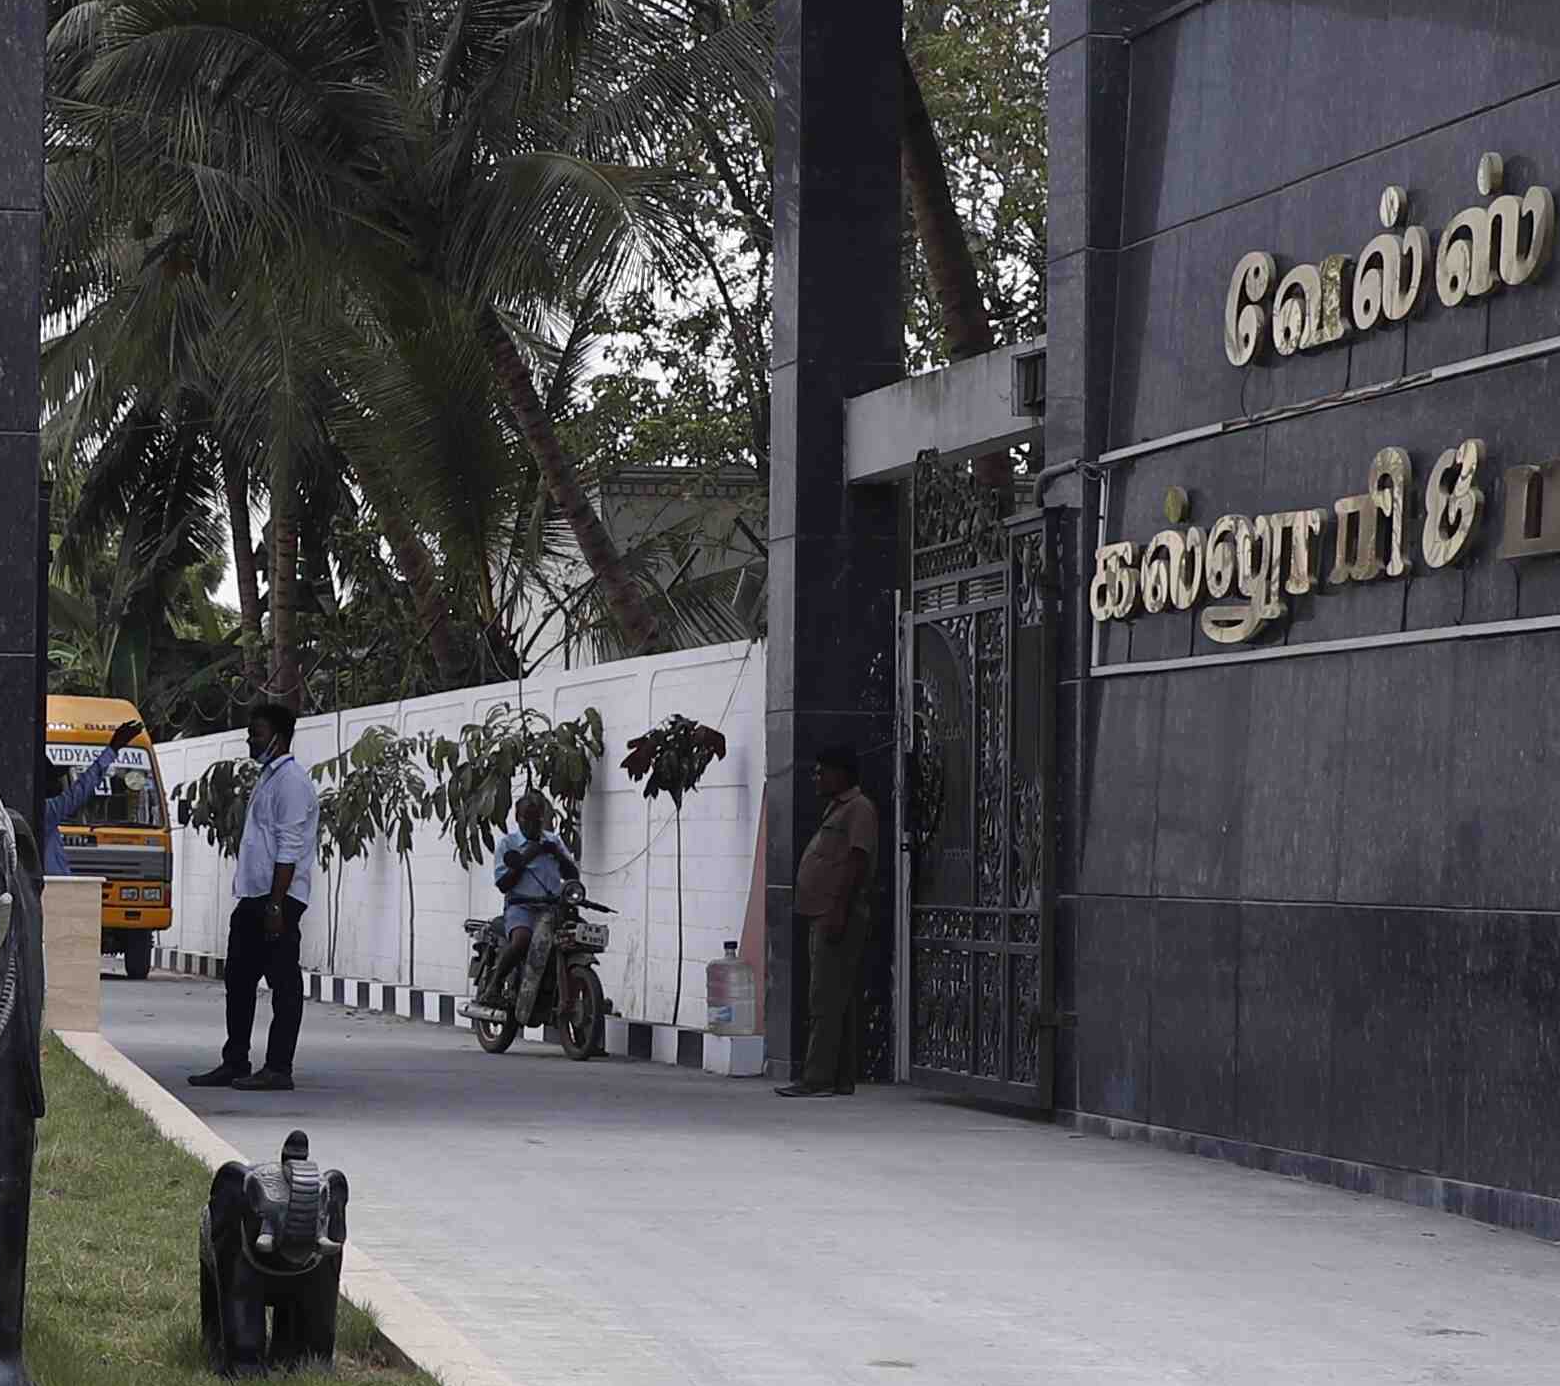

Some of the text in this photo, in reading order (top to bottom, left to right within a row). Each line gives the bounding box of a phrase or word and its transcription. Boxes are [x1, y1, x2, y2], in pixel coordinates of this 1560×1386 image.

[1223, 151, 1555, 367] வேல்ஸ்
[1089, 445, 1412, 645] கல்லூரி
[49, 748, 144, 765] VIDYASAM
